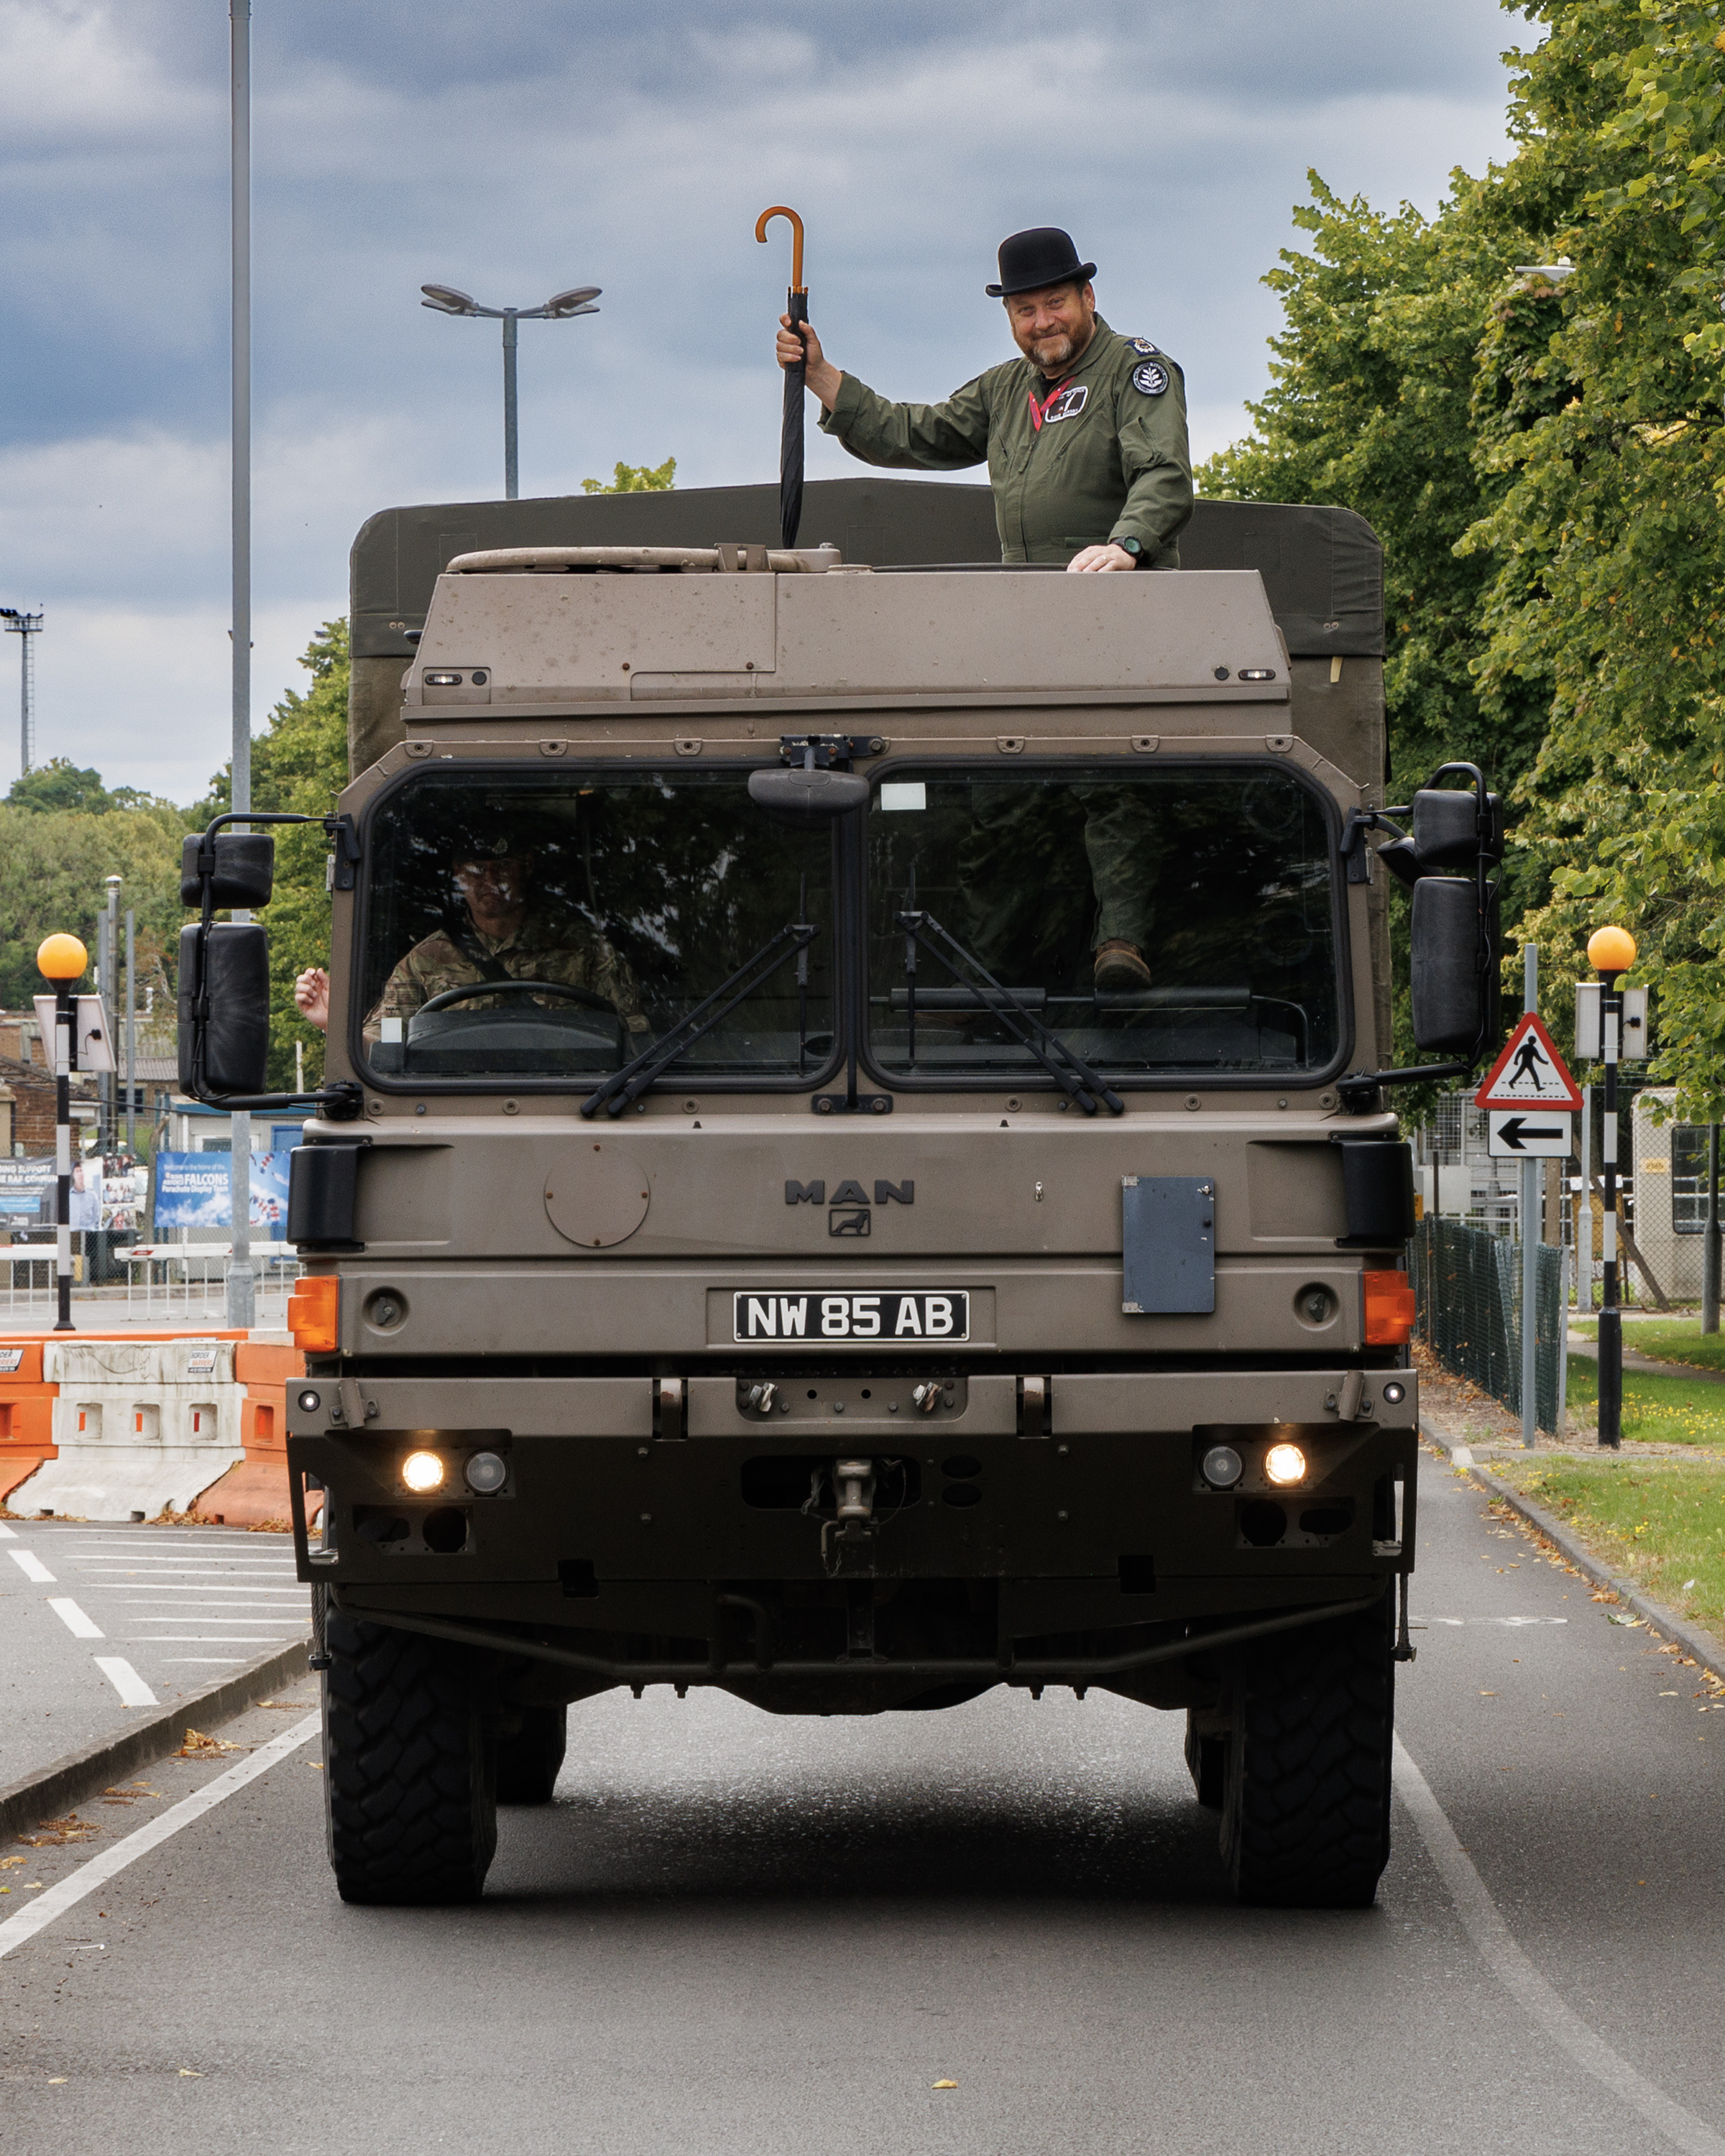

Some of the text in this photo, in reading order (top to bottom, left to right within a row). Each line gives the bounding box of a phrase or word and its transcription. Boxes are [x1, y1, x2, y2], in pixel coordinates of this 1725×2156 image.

[185, 1174, 229, 1185] FALCONS
[786, 1179, 914, 1204] MAN
[748, 1297, 954, 1336] NW 85 AB
